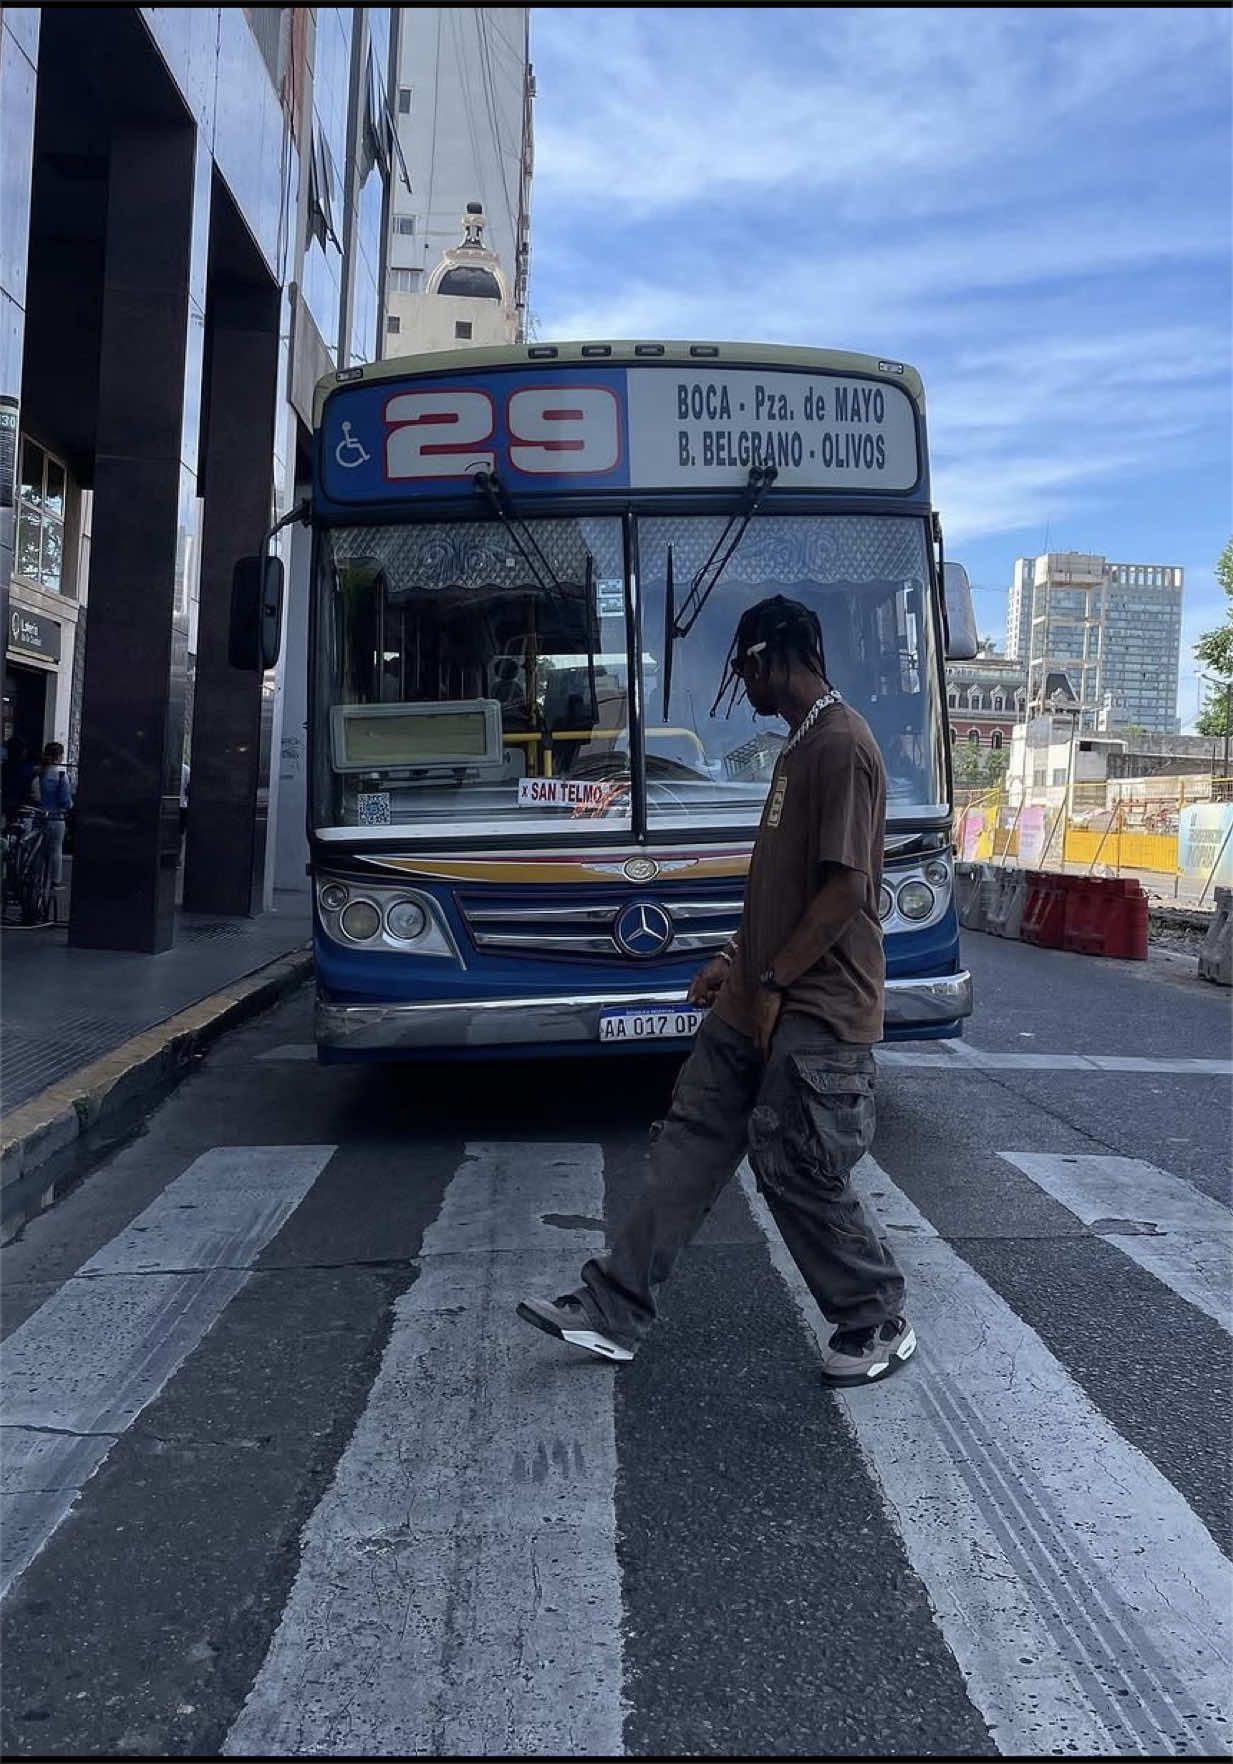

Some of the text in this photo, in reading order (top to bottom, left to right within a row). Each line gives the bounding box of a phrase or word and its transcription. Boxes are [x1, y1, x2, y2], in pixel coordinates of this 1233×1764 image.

[677, 384, 731, 420] BOCA
[754, 385, 794, 421] Pza.
[803, 387, 825, 421] de
[834, 387, 885, 423] MAYO
[384, 385, 621, 483] 29
[678, 431, 696, 466] B.
[703, 431, 802, 467] BELGRANO
[822, 433, 886, 469] OLIVOS
[531, 782, 557, 800] SAN
[561, 784, 602, 803] TELMO
[605, 1015, 698, 1038] AA 017 OP
